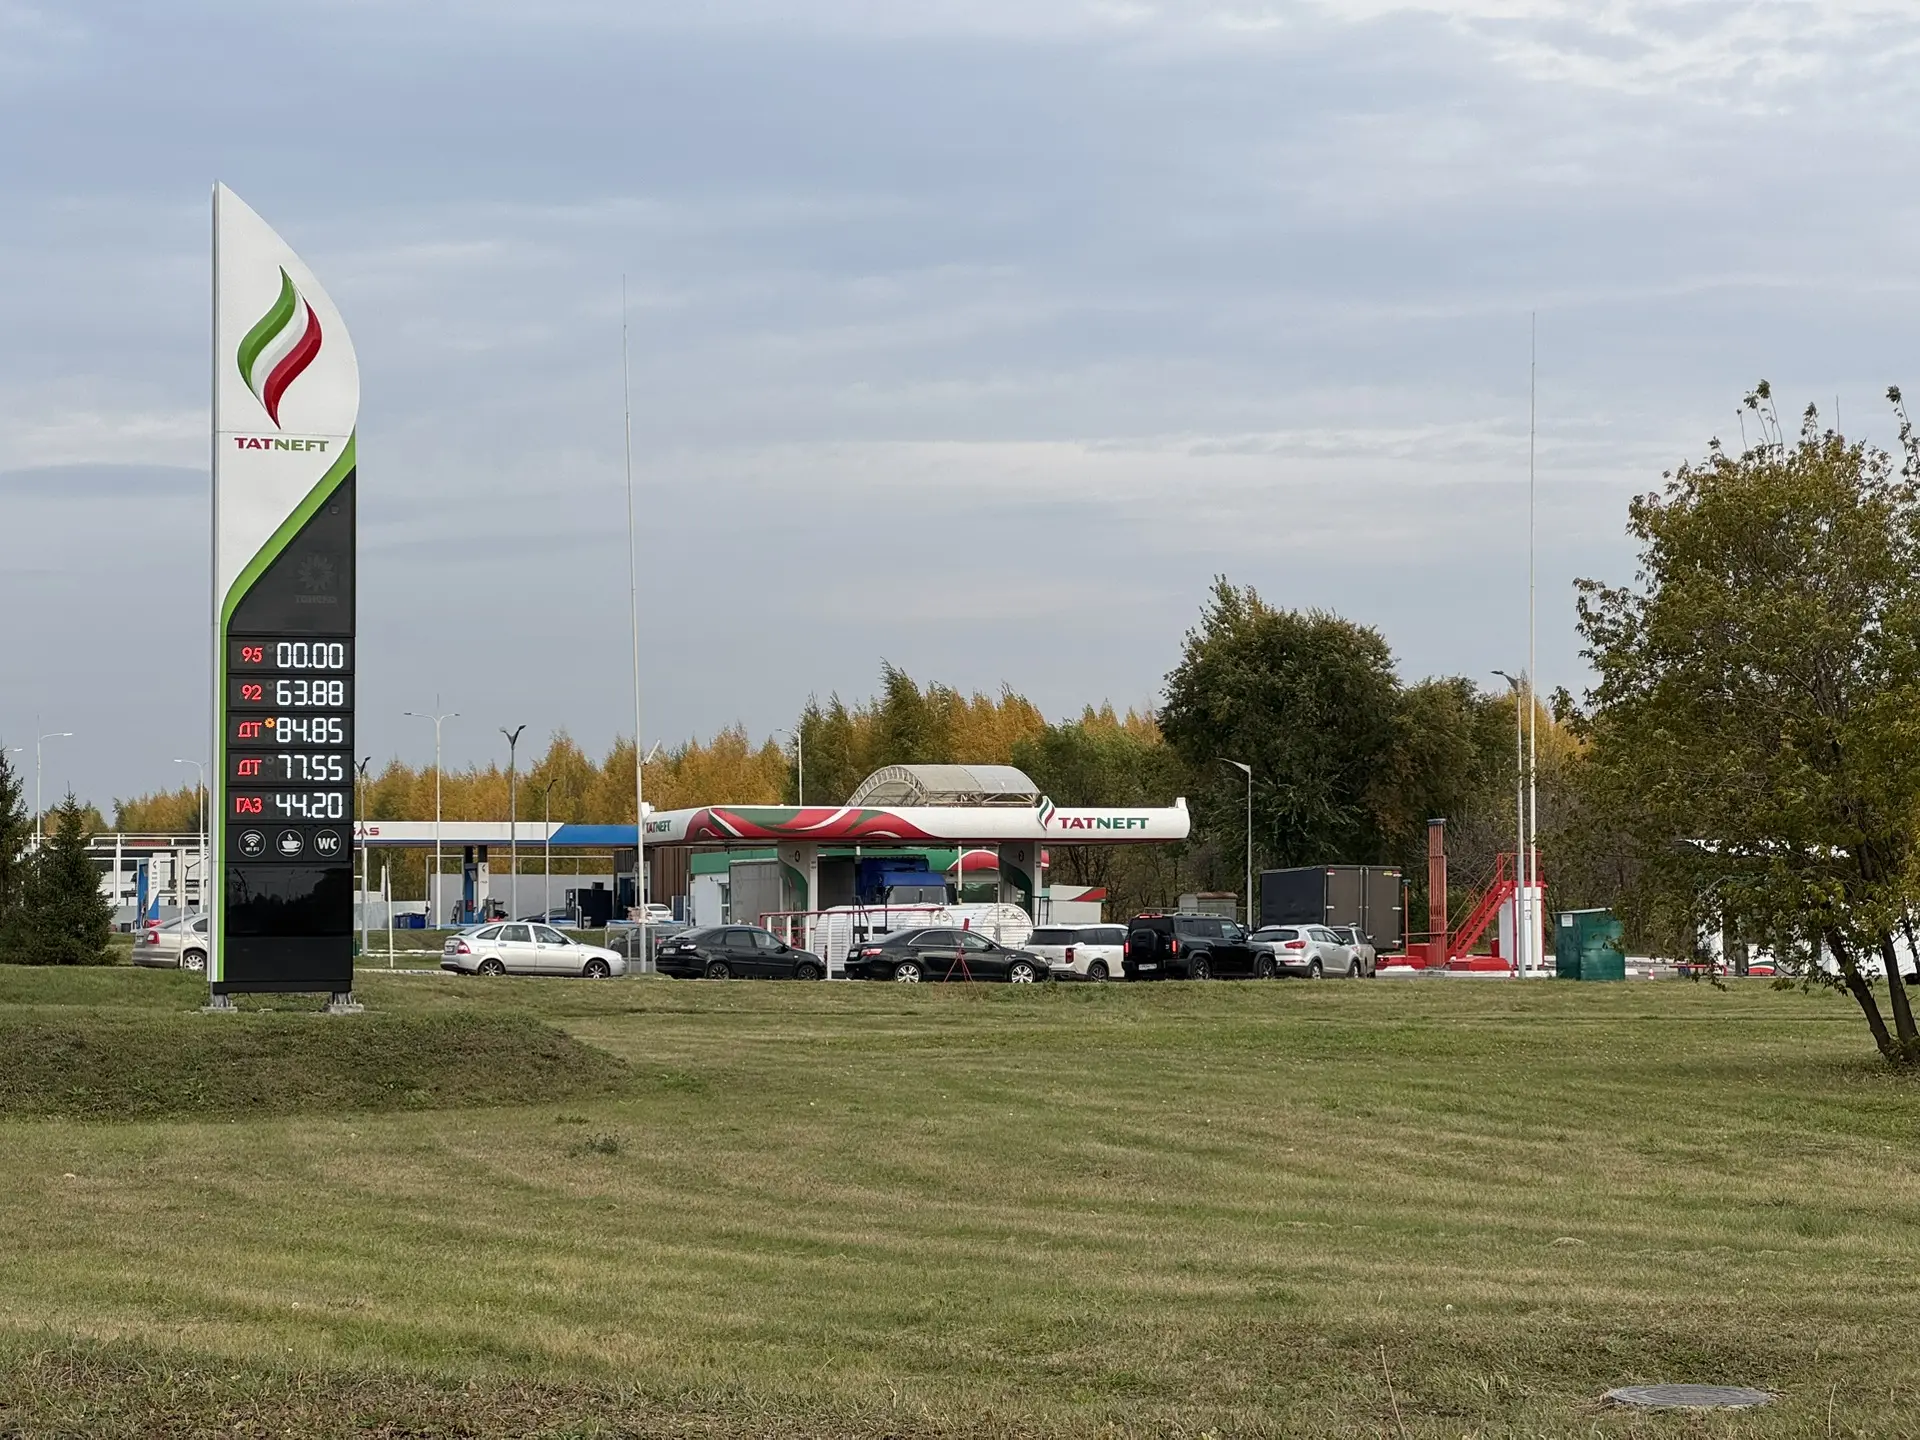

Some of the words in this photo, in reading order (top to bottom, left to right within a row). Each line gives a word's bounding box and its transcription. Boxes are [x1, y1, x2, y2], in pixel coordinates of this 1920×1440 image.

[234, 437, 329, 452] TATNEFT
[242, 646, 263, 662] 95
[277, 642, 343, 668] 00.00
[242, 684, 262, 700] 92
[277, 680, 343, 706] 63.88
[238, 721, 262, 738] ДТ
[276, 717, 343, 743] 84.85
[237, 759, 262, 776] ДТ
[277, 754, 343, 781] 77.55
[236, 797, 263, 813] ГАЗ
[275, 793, 343, 818] 44.20
[646, 820, 672, 833] TATNEFT
[1058, 817, 1149, 829] TATNEFT
[317, 837, 337, 850] WC
